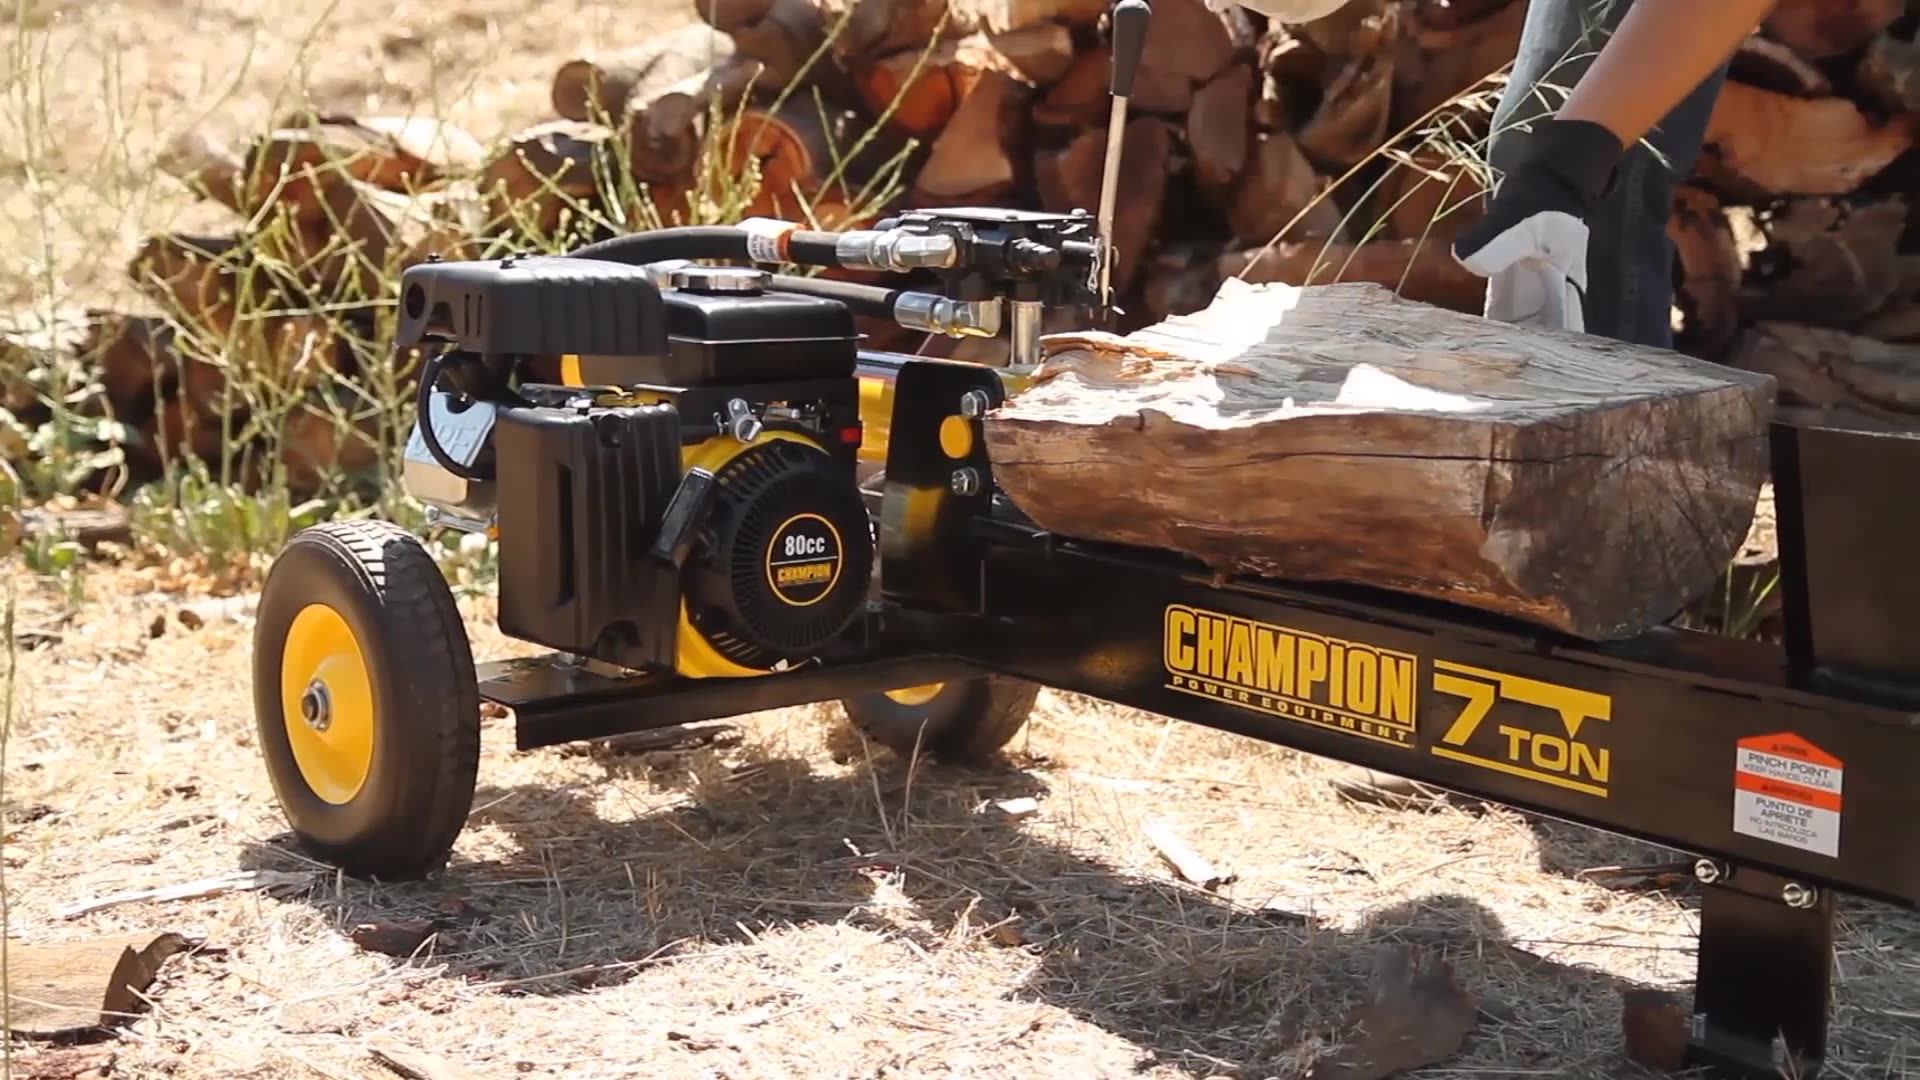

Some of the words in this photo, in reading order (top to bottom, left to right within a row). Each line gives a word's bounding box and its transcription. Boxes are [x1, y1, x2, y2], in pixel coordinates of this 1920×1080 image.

[785, 535, 826, 556] 80cc
[1166, 605, 1417, 730] CHAMPION
[1173, 676, 1249, 703] POWER
[1261, 698, 1408, 742] EQUIPMENT
[1433, 673, 1496, 747] 7
[1499, 725, 1609, 783] TON
[1748, 752, 1787, 770] PINCH
[1790, 761, 1830, 779] POINT
[1802, 776, 1834, 788] CLEAR
[1755, 797, 1796, 814] PUNTO
[1798, 807, 1813, 818] DE
[1761, 809, 1808, 827] APRIETE
